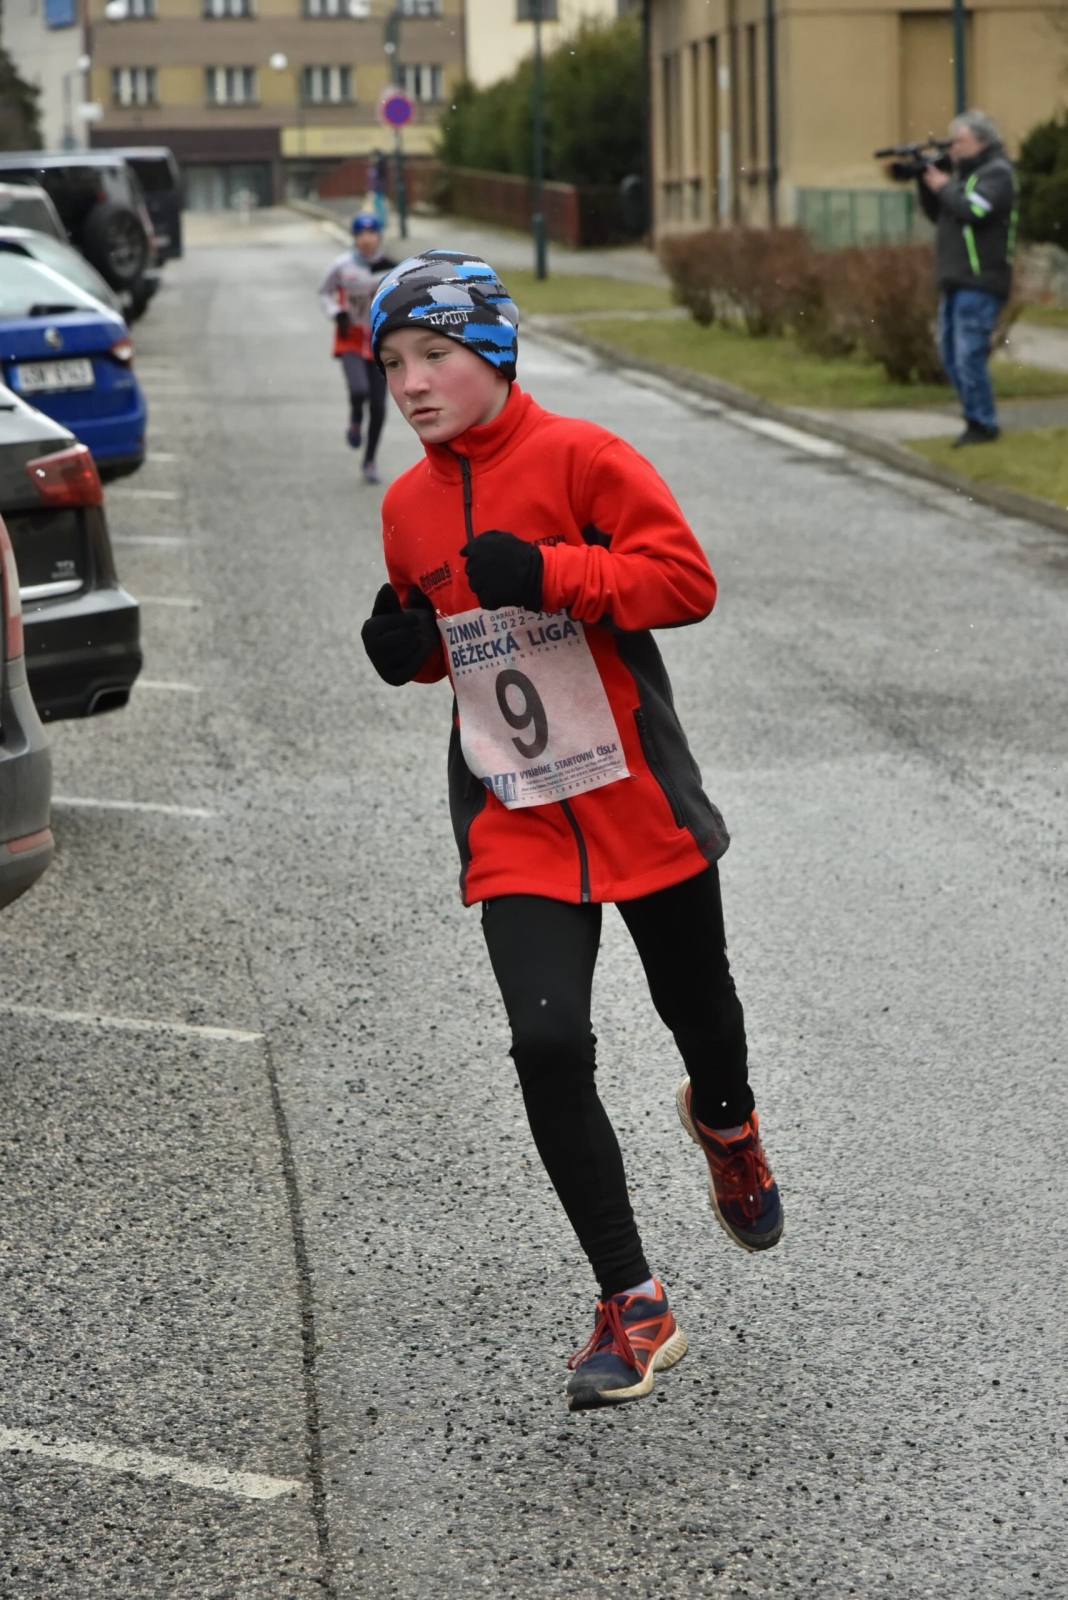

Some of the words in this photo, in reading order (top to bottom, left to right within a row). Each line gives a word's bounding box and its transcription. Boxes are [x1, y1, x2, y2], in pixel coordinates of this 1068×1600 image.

[446, 615, 487, 645] ZIMNÍ
[452, 631, 521, 668] BĚŽECKÁ
[527, 620, 578, 646] LIGA
[496, 669, 548, 759] 9
[520, 763, 552, 780] VYRÁBÍME
[554, 749, 595, 770] STARTOVNÍ
[597, 743, 618, 756] ČÍSLA
